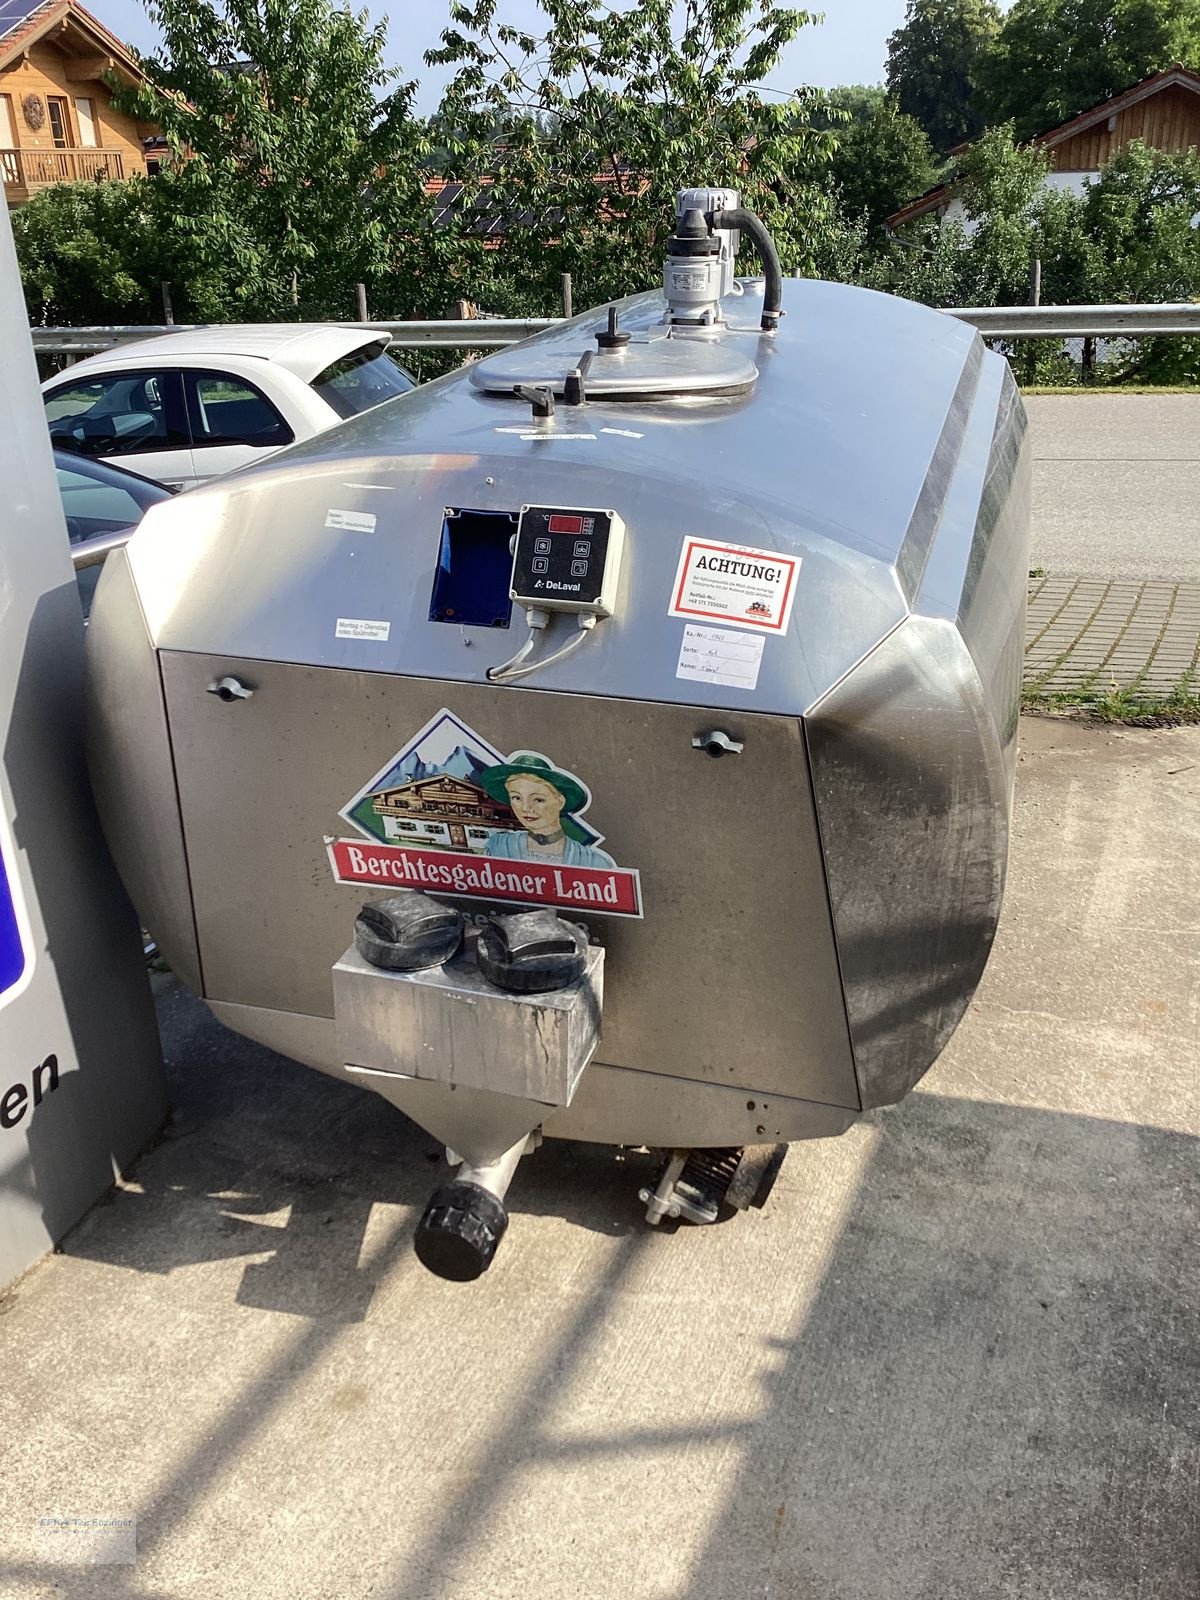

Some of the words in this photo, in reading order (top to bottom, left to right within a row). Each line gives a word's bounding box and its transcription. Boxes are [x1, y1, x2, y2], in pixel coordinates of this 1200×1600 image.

[696, 555, 782, 583] ACHTUNG!
[546, 580, 581, 592] DeLaval
[683, 646, 699, 654] Sorte:
[680, 662, 697, 670] Name:
[347, 847, 547, 895] Berchtesgadener
[553, 870, 619, 904] Land
